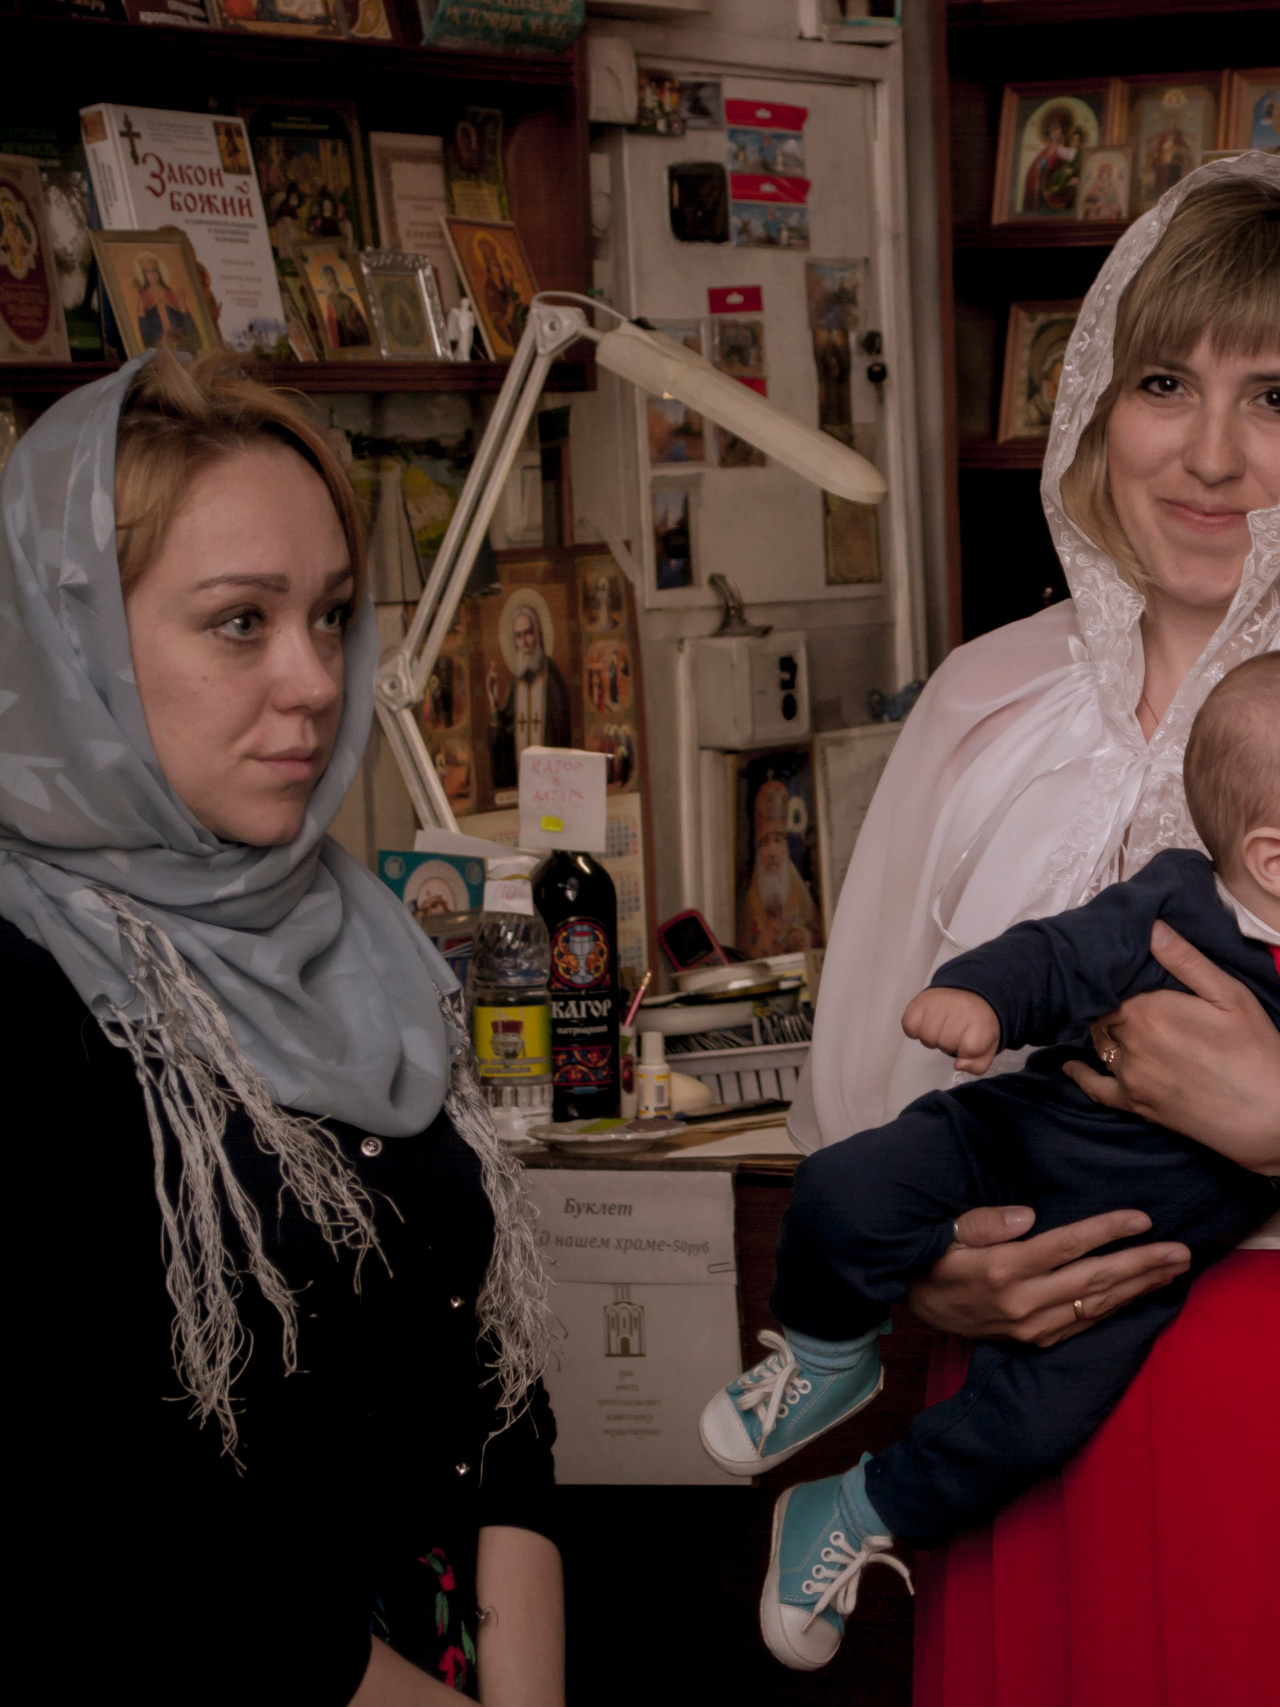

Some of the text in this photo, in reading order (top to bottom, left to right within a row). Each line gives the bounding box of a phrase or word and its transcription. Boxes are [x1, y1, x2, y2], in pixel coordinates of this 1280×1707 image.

[531, 759, 583, 775] КАГОР
[551, 998, 613, 1019] КАГОР
[563, 1198, 633, 1218] Буклет
[555, 1233, 611, 1250] нашем
